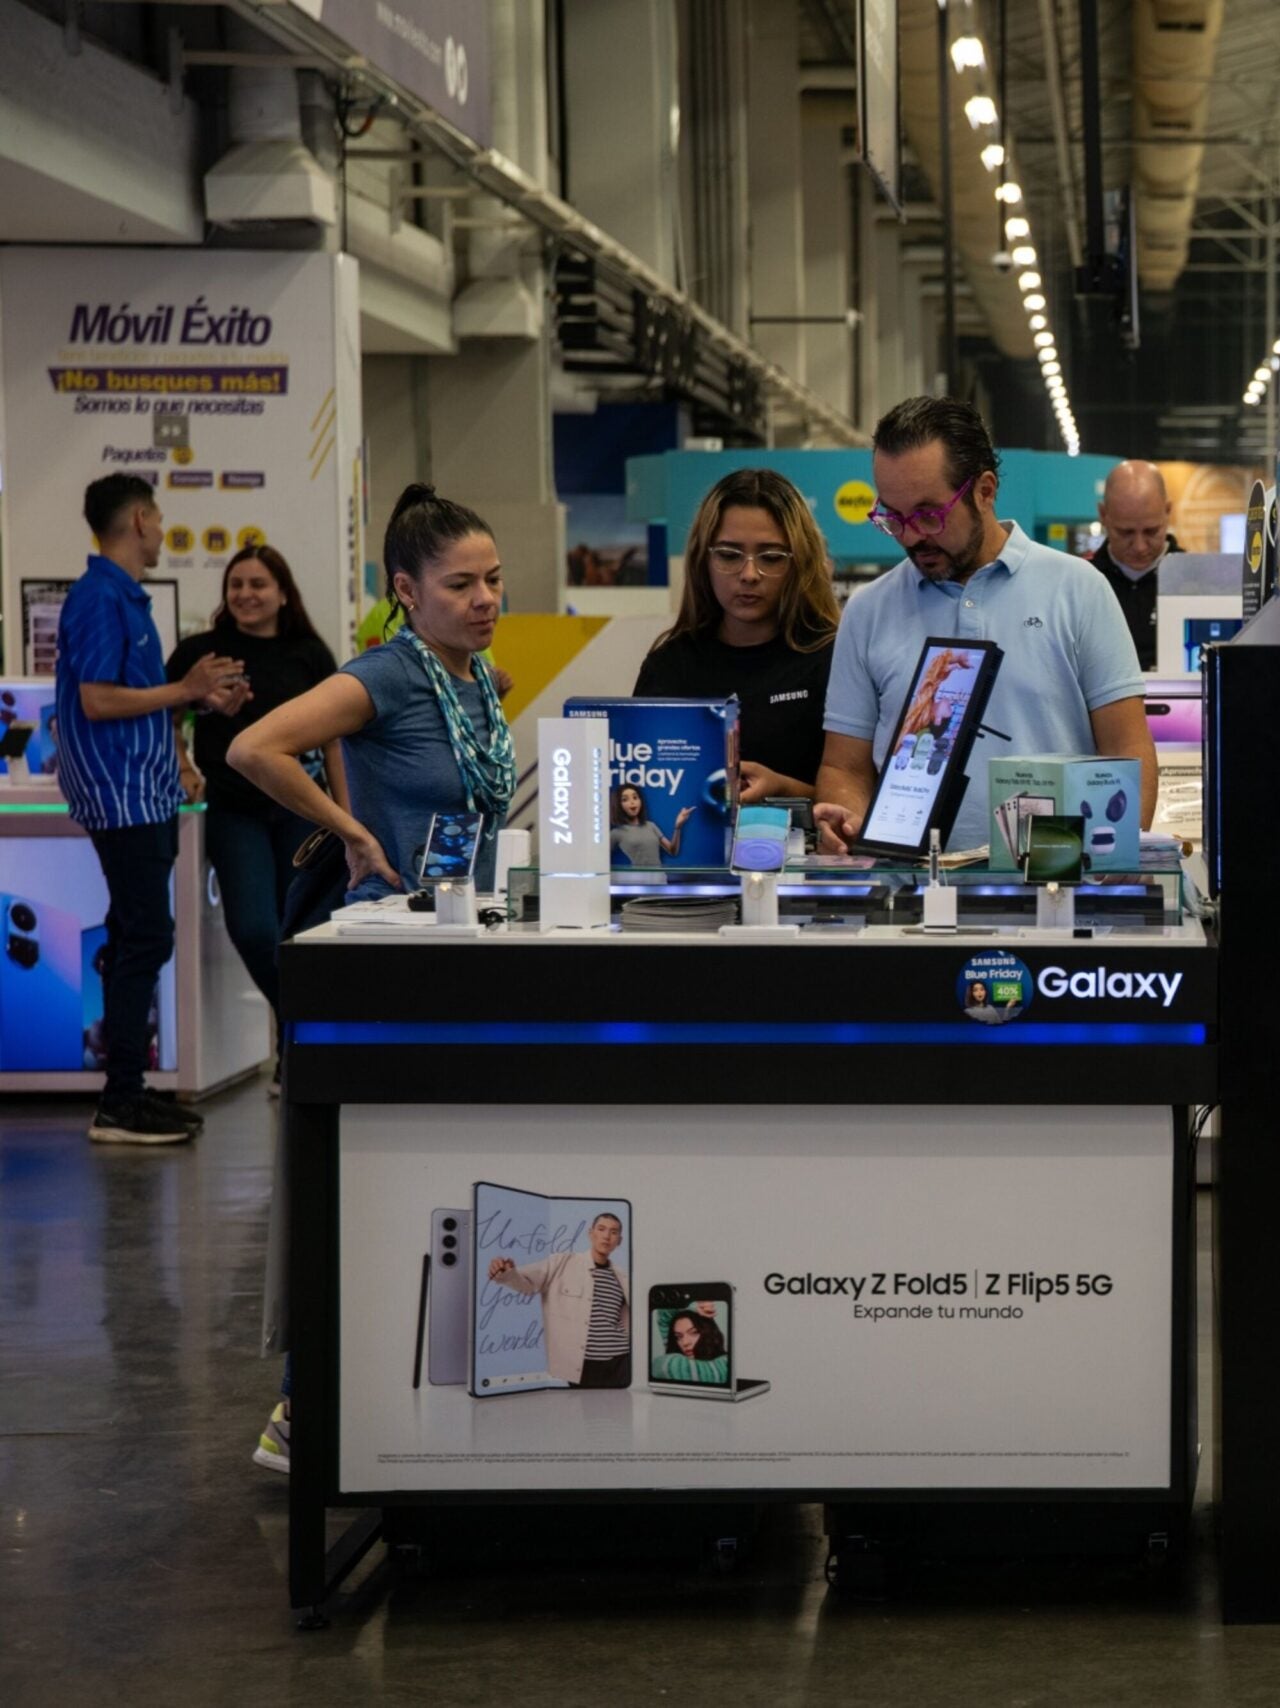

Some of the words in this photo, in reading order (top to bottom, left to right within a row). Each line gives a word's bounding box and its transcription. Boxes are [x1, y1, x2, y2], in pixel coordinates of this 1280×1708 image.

[69, 303, 175, 345] Móvil
[180, 296, 273, 346] Éxito
[107, 371, 213, 395] busques
[221, 371, 282, 393] más!
[770, 690, 809, 704] SAMSUNG
[569, 710, 608, 718] SAMSUNG
[610, 738, 653, 762] lue
[549, 747, 572, 829] Galaxy
[610, 763, 685, 796] riday
[553, 831, 573, 844] Z
[971, 957, 1016, 966] SAMSUNG
[965, 970, 988, 980] Blue
[989, 968, 1023, 981] Friday
[1037, 966, 1183, 1007] Galaxy
[997, 987, 1019, 996] 40%
[477, 1209, 587, 1255] Unfold
[764, 1272, 867, 1301] Galaxy
[871, 1273, 887, 1295] Z
[894, 1272, 968, 1296] Fold5
[985, 1274, 1001, 1296] Z
[1008, 1271, 1070, 1302] Flip5
[1076, 1274, 1114, 1296] 5G
[853, 1303, 933, 1323] Expande
[938, 1304, 955, 1319] tu
[959, 1303, 1024, 1319] mundo
[478, 1320, 545, 1355] world
